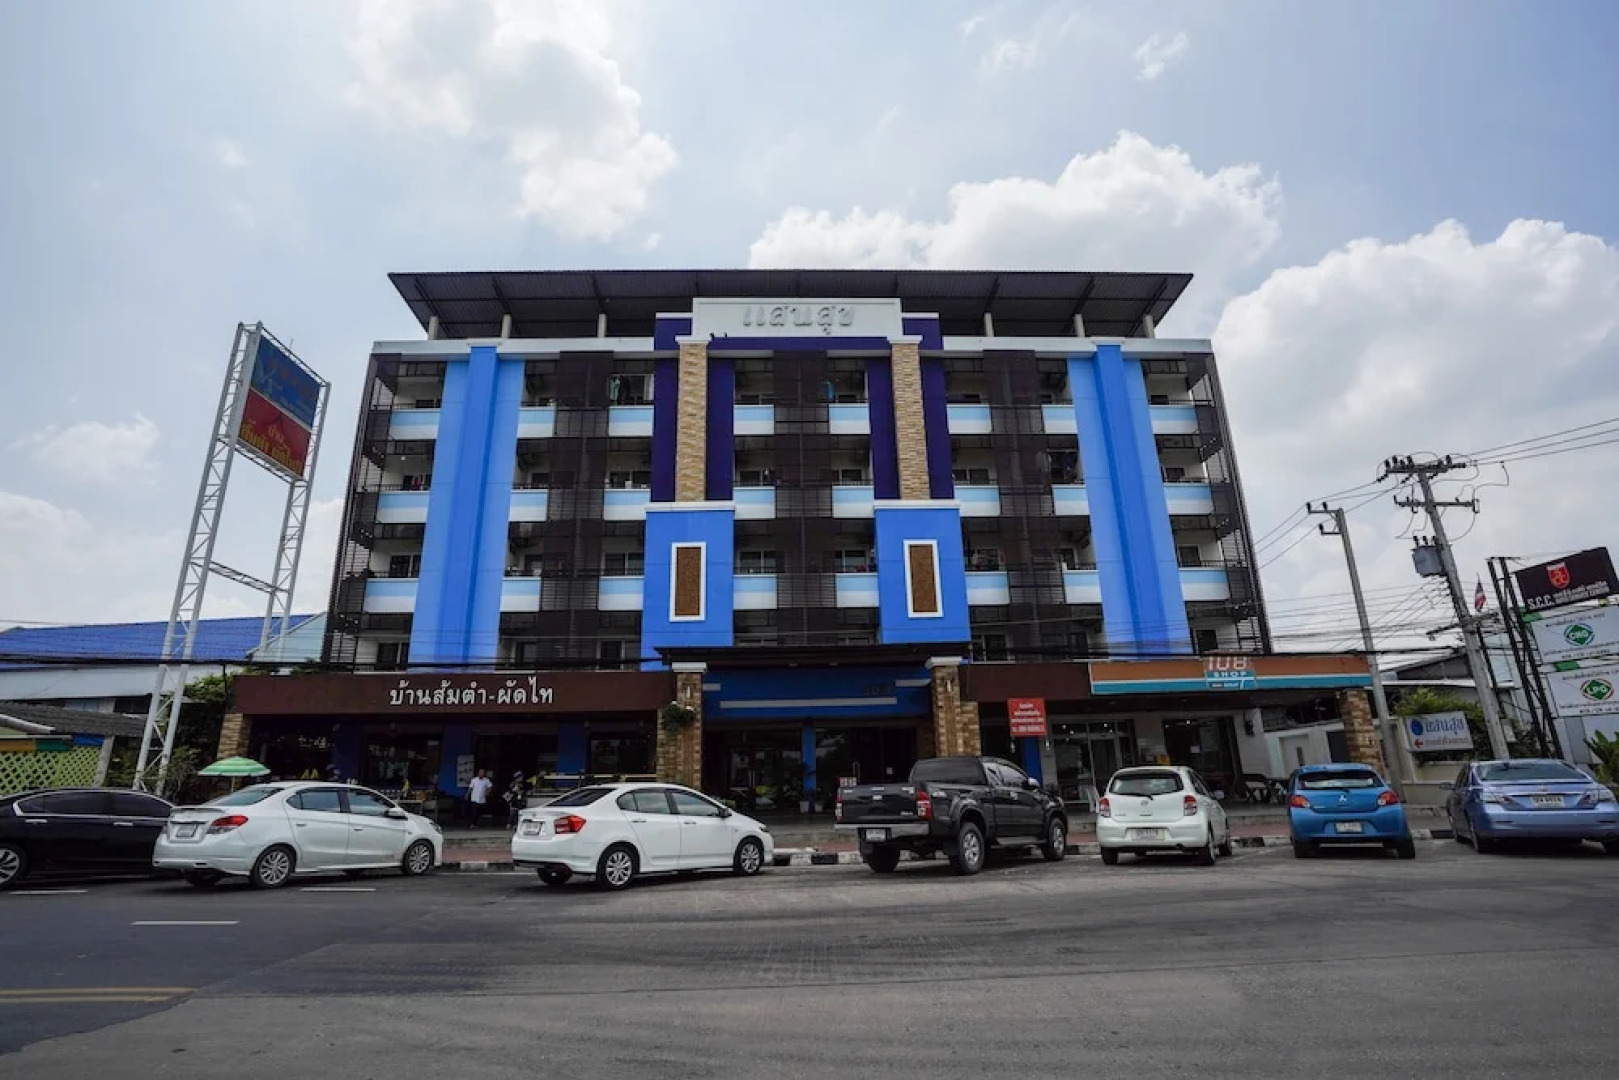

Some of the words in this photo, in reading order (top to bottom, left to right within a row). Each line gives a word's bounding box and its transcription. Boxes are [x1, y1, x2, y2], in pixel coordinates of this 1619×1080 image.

[742, 305, 854, 335] แสนสุข
[1208, 655, 1248, 671] 108
[389, 676, 555, 706] บ้านส้มตำ-ผัดไท
